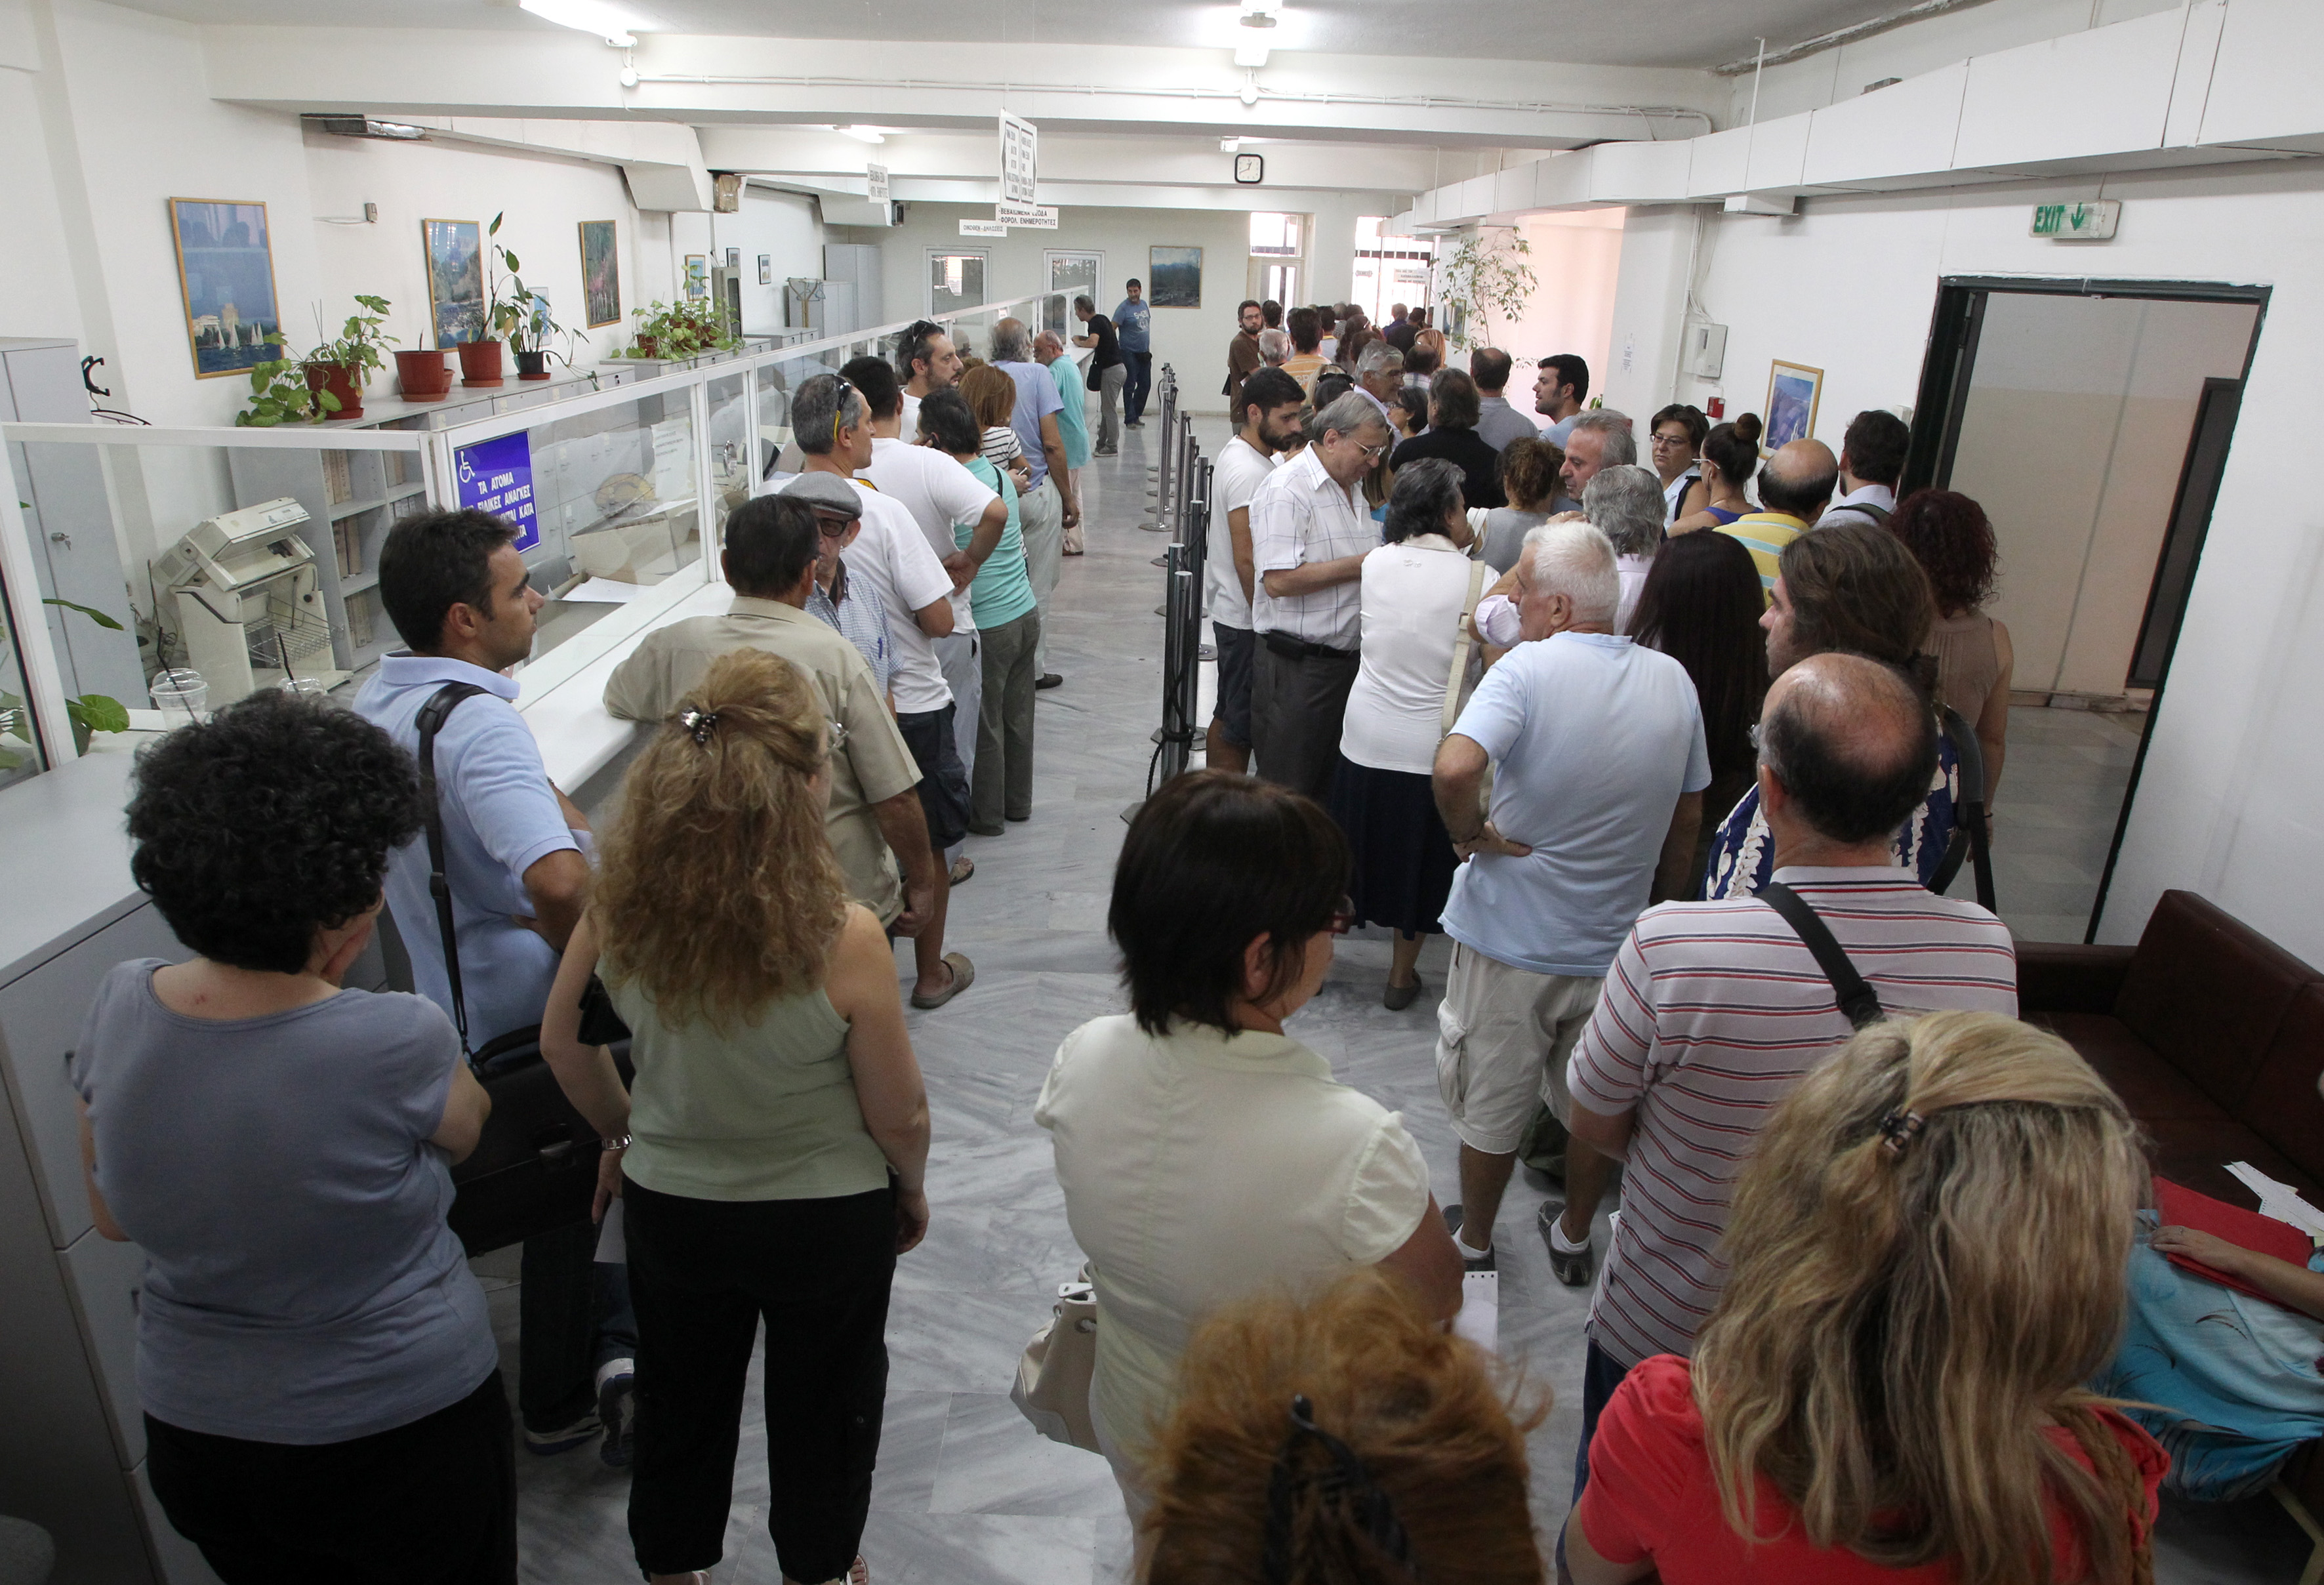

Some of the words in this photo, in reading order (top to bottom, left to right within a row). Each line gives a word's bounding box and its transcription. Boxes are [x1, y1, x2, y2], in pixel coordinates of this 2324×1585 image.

[1020, 217, 1056, 226] ΕΝΗΜΕΡΟΤΗΤΕΣ
[2033, 205, 2065, 232] EXIT
[477, 480, 488, 495] ΤΑ
[491, 472, 514, 491] ΑΤΟΜΑ
[504, 484, 531, 506] ΑΝΑΓΚΕΣ
[518, 502, 535, 520] ΚΑΤΑ
